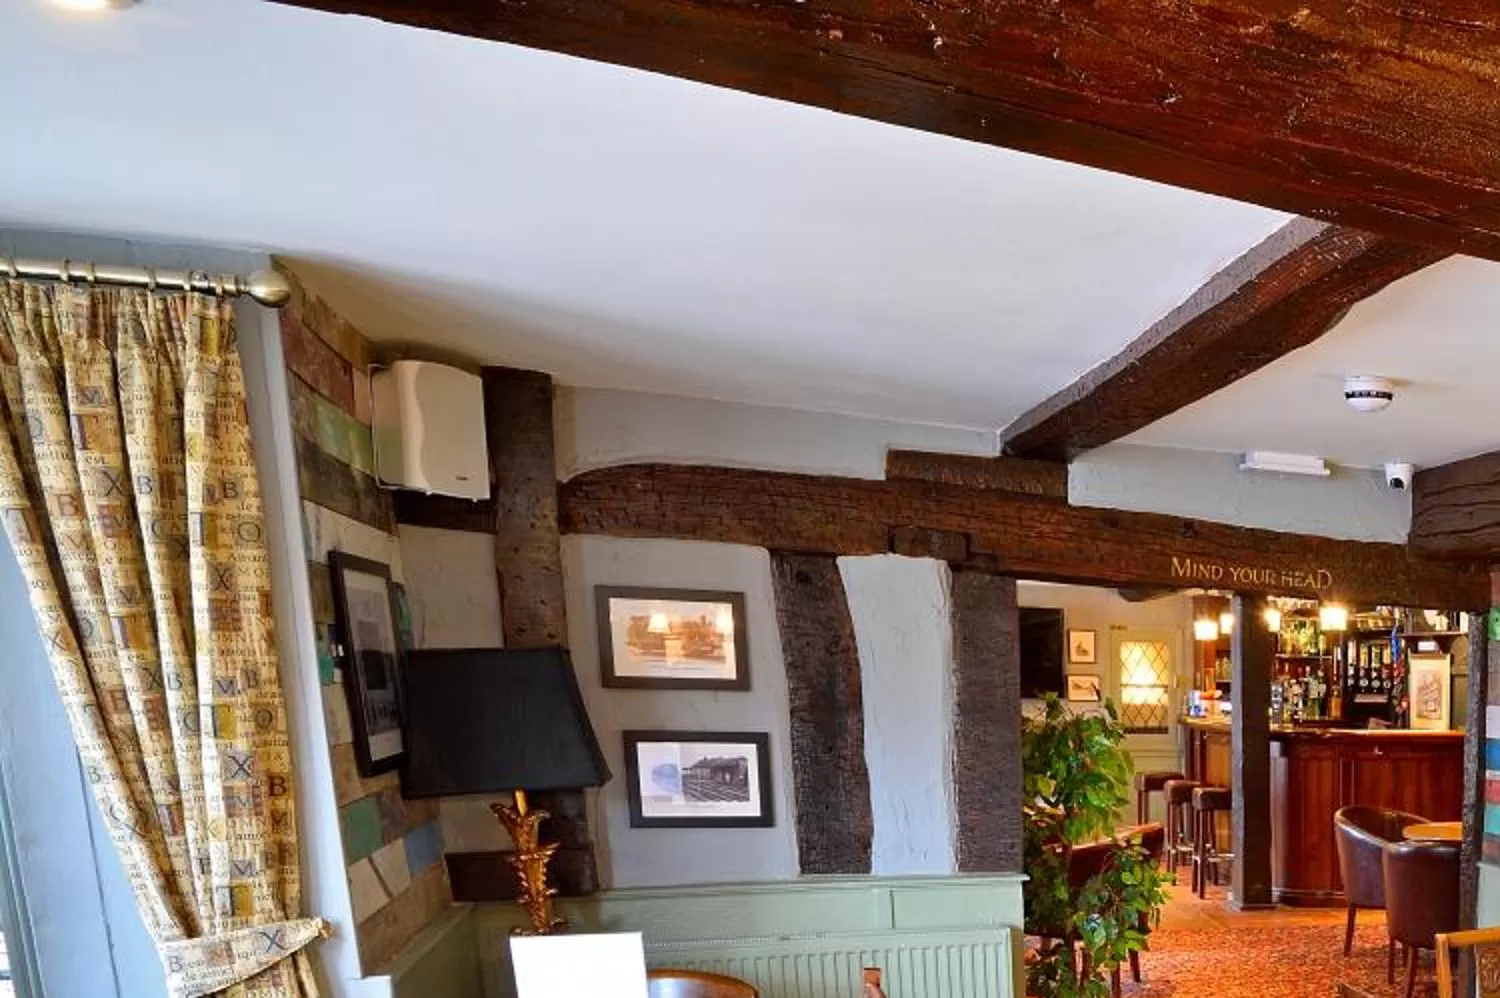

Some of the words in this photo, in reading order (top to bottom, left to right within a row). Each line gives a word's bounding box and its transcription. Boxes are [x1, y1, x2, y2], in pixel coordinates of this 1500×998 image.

[1171, 556, 1223, 580] MIND
[1229, 566, 1276, 585] YOUR
[1281, 569, 1333, 590] HEAD
